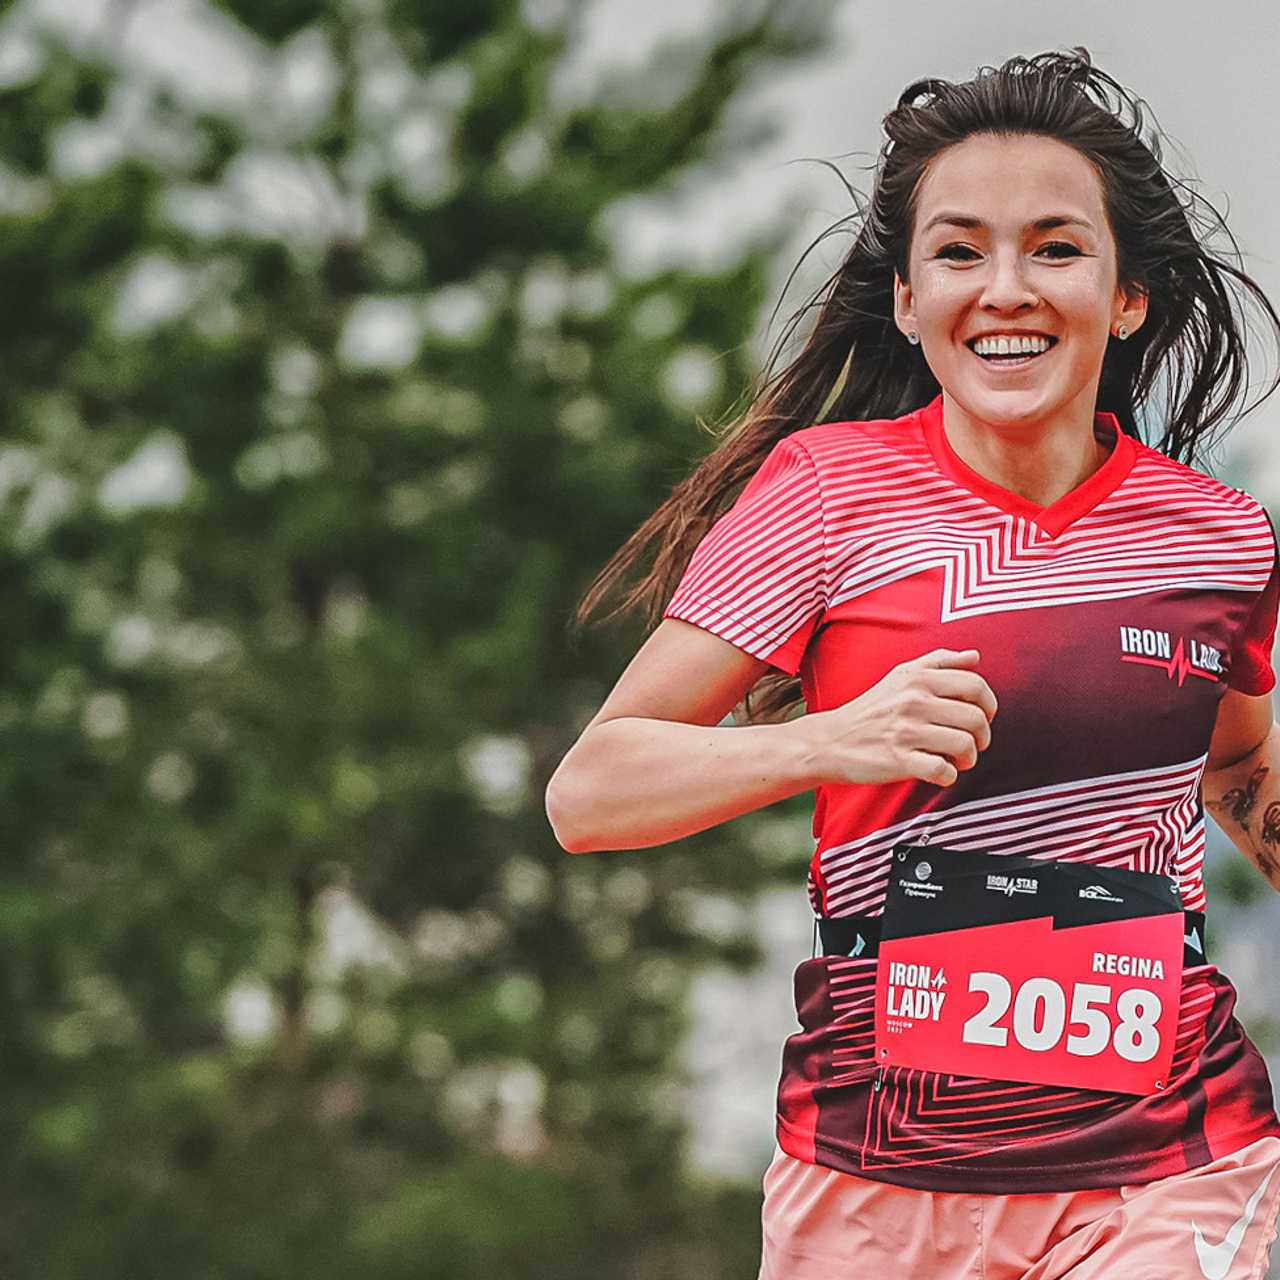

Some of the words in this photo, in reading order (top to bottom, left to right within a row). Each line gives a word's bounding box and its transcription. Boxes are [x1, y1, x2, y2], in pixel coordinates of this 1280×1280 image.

[1119, 626, 1171, 659] IRON
[986, 874, 1009, 887] IRON
[1015, 877, 1039, 890] STAR
[888, 962, 931, 989] IRON
[1092, 952, 1165, 980] REGINA
[886, 986, 946, 1022] LADY
[962, 971, 1163, 1063] 2058
